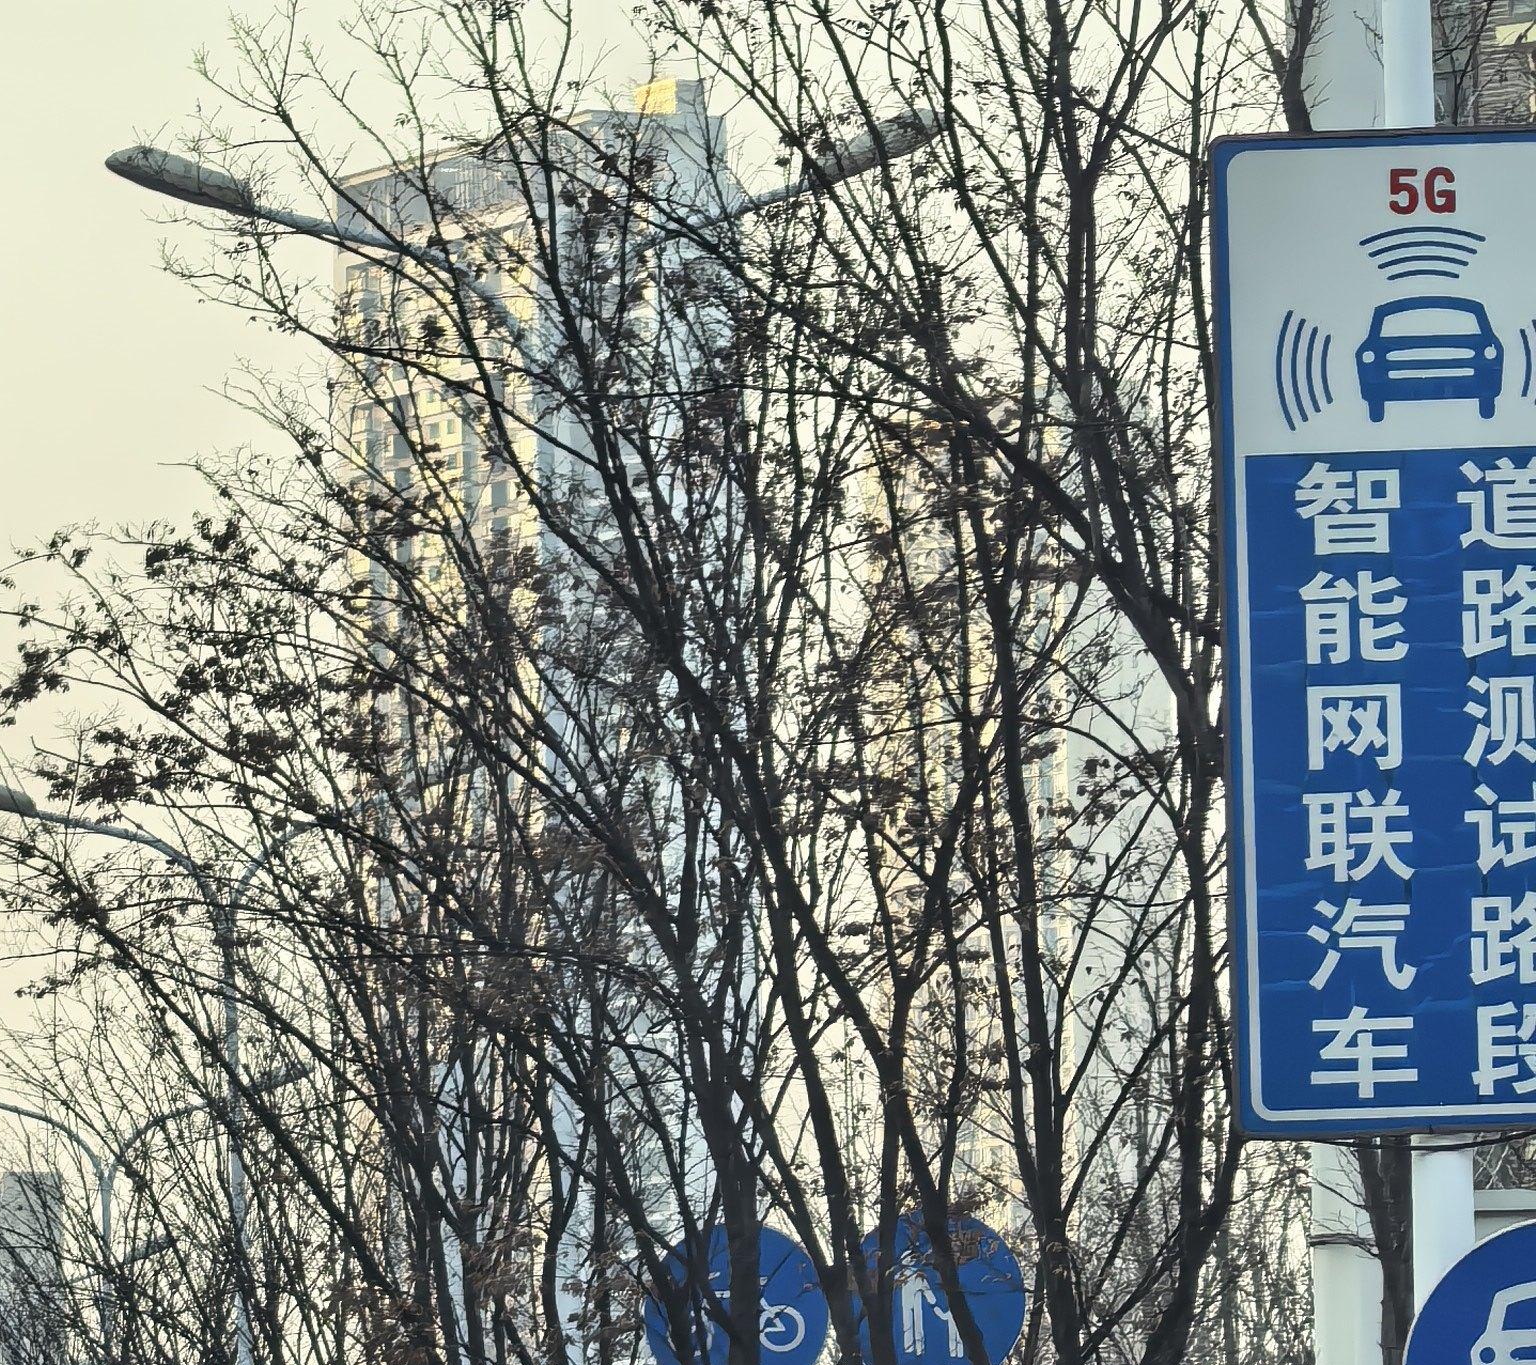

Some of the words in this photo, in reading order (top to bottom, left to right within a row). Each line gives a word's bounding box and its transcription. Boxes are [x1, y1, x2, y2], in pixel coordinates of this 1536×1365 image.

[1388, 167, 1458, 214] 5G
[1293, 462, 1419, 1100] 智能网联汽车
[1456, 456, 1536, 1099] 道路测试路段
